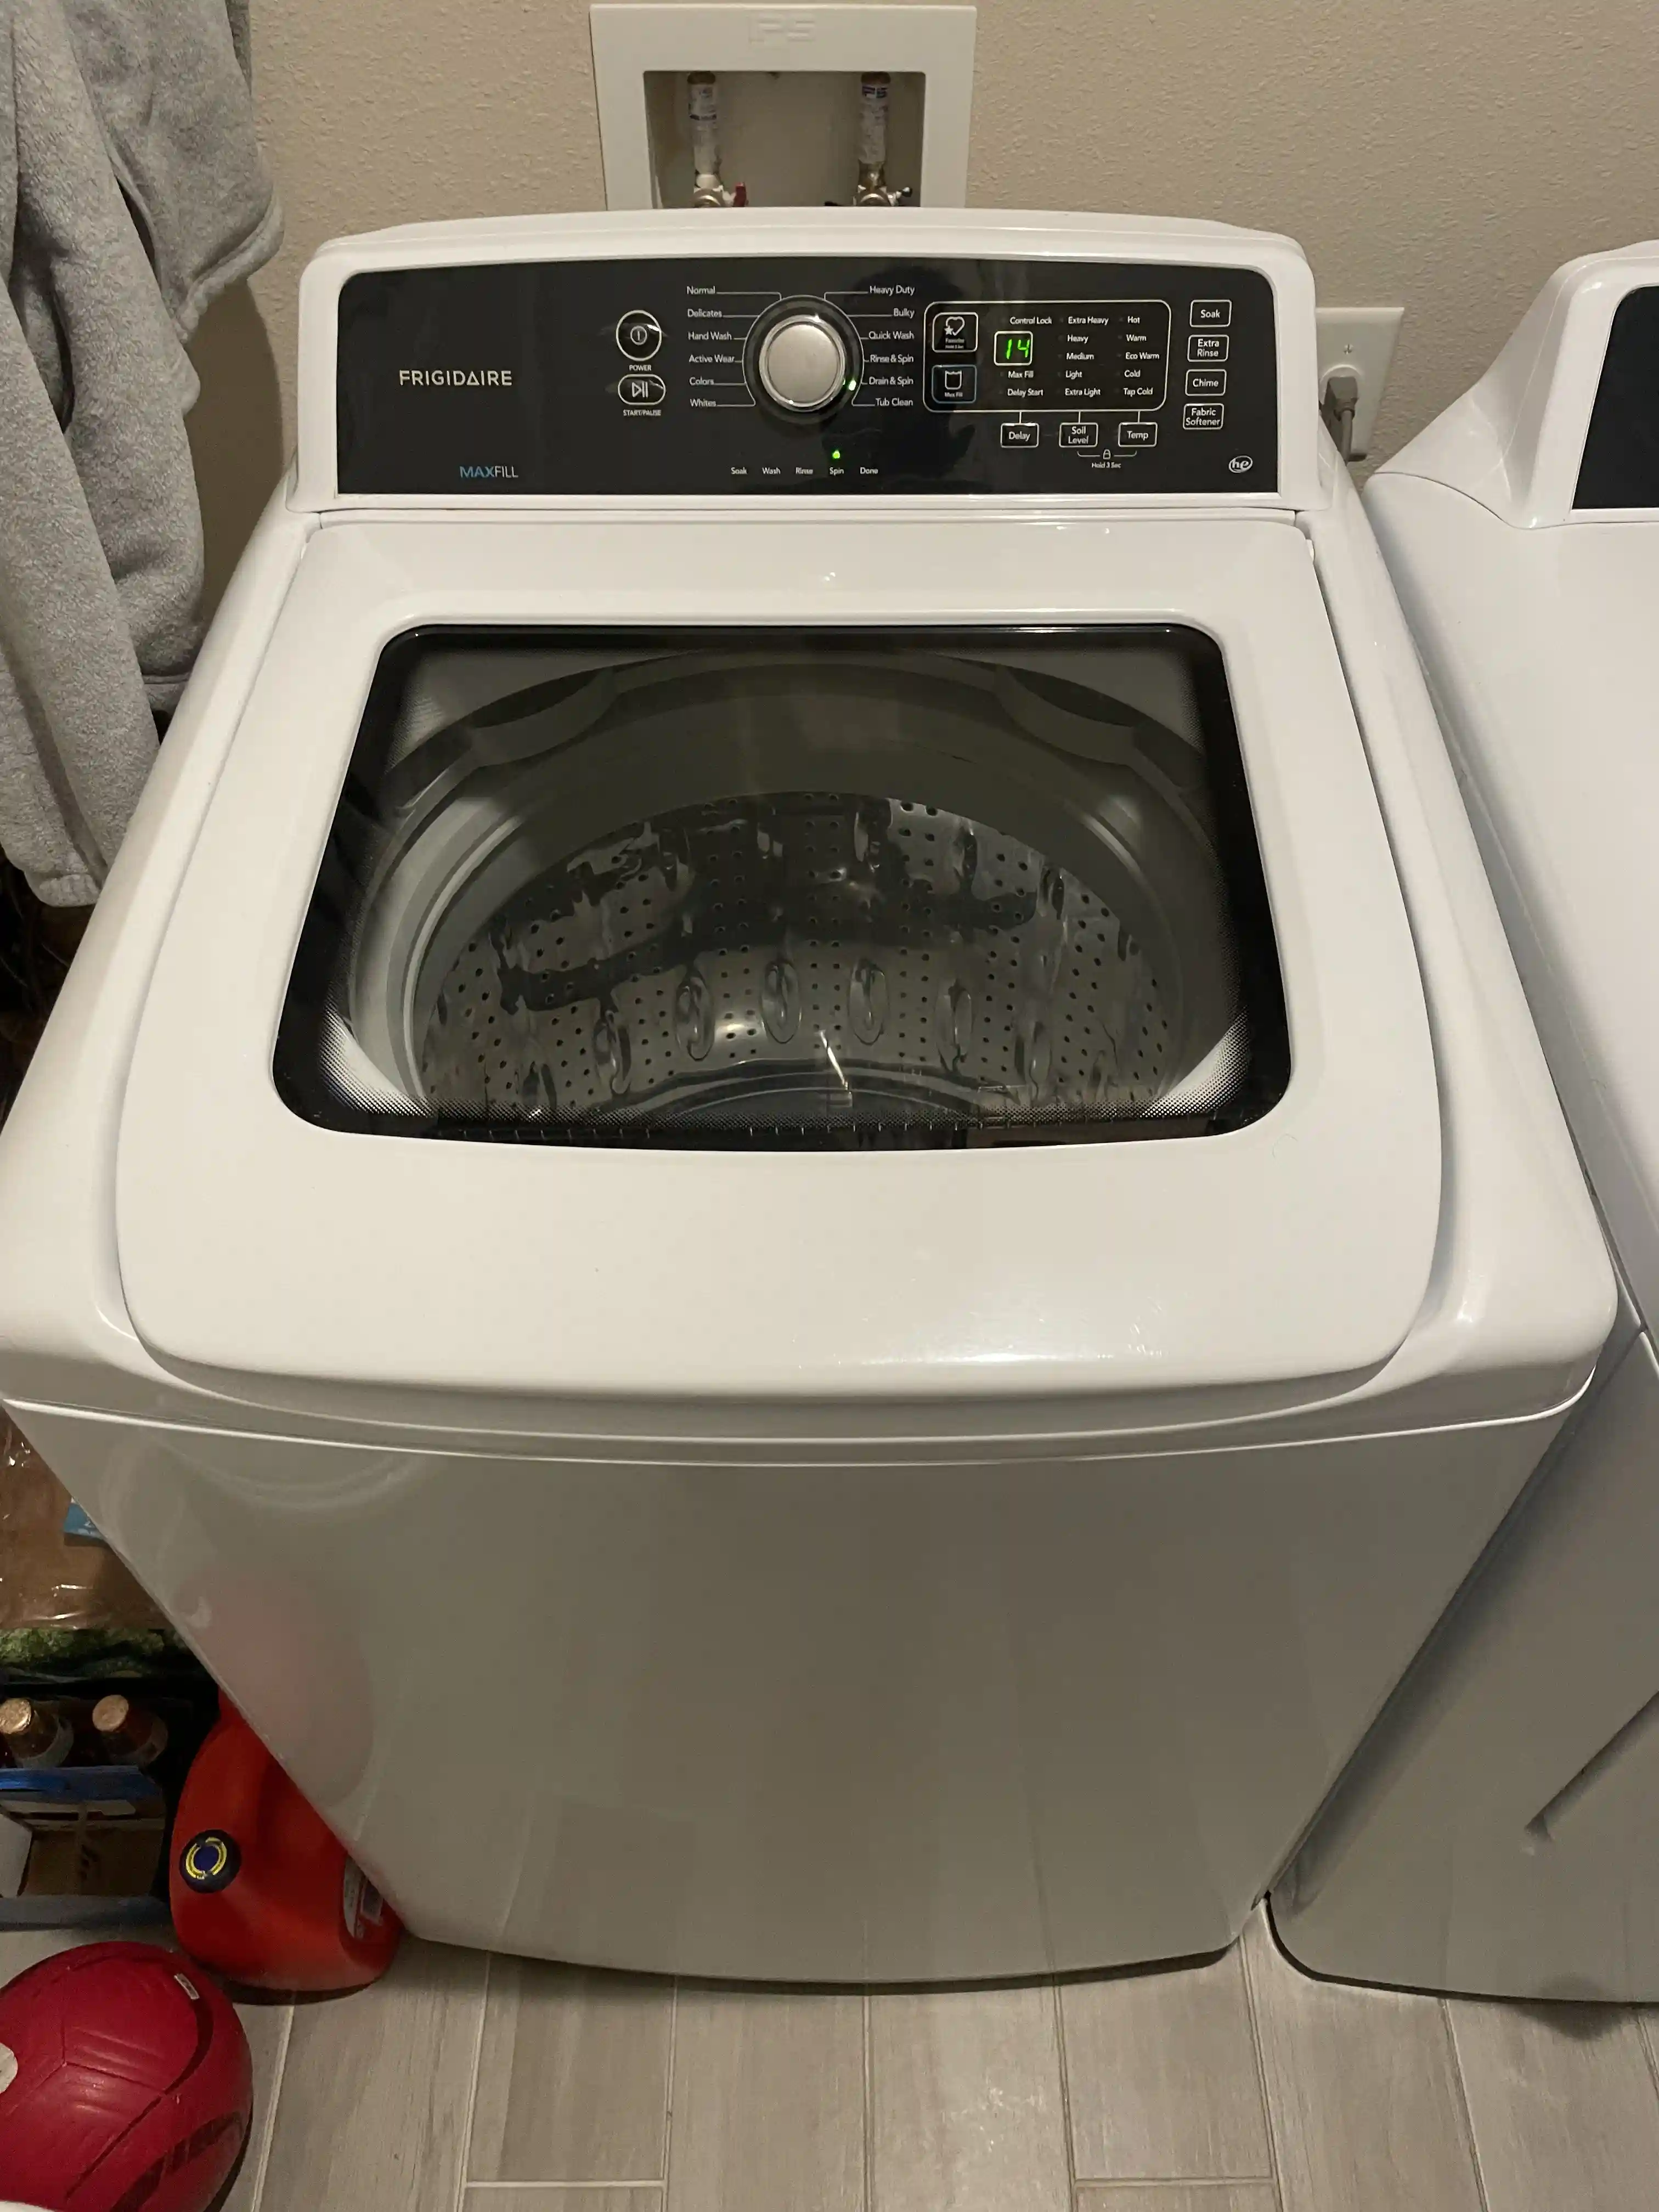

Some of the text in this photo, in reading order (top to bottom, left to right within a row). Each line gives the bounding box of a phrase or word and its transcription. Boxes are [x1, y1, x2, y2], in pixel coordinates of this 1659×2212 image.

[686, 286, 715, 295] Normal
[870, 286, 915, 295] Heavy Duty
[687, 309, 723, 318] Delicates
[893, 308, 915, 318] Bulky
[1200, 309, 1220, 318] Soak
[1087, 317, 1109, 326] Heavy
[688, 331, 732, 340] Hand Wash
[868, 331, 915, 340] Quick Wash
[1067, 335, 1088, 344] Heavy
[1198, 339, 1220, 348] Extra
[1006, 338, 1030, 359] 14
[1197, 349, 1218, 357] Rinse
[689, 354, 735, 363] Active Wear
[870, 354, 890, 363] Rinse
[898, 354, 914, 364] Spin
[399, 370, 512, 386] FRIGIDAIRE
[1065, 370, 1082, 379] Light
[690, 377, 714, 385] Colors
[869, 376, 889, 385] Drain
[897, 376, 913, 387] Spin
[1192, 379, 1218, 387] Chime
[1007, 388, 1027, 398] Delay
[1084, 388, 1101, 397] Light
[1124, 387, 1153, 397] Tap Cold
[690, 399, 716, 407] Whites
[876, 398, 913, 407] Tub Clean
[1191, 408, 1216, 416] Fabric
[1186, 417, 1220, 426] Softener
[1071, 426, 1086, 435] Soil
[1008, 432, 1030, 442] Delay
[1068, 436, 1089, 444] Level
[1127, 431, 1149, 441] Temp
[460, 466, 518, 478] MAXFILL
[731, 467, 747, 475] Soak
[762, 467, 781, 475] Wash
[795, 467, 813, 475] Rinse
[830, 467, 844, 477] Spin
[860, 467, 878, 475] Done
